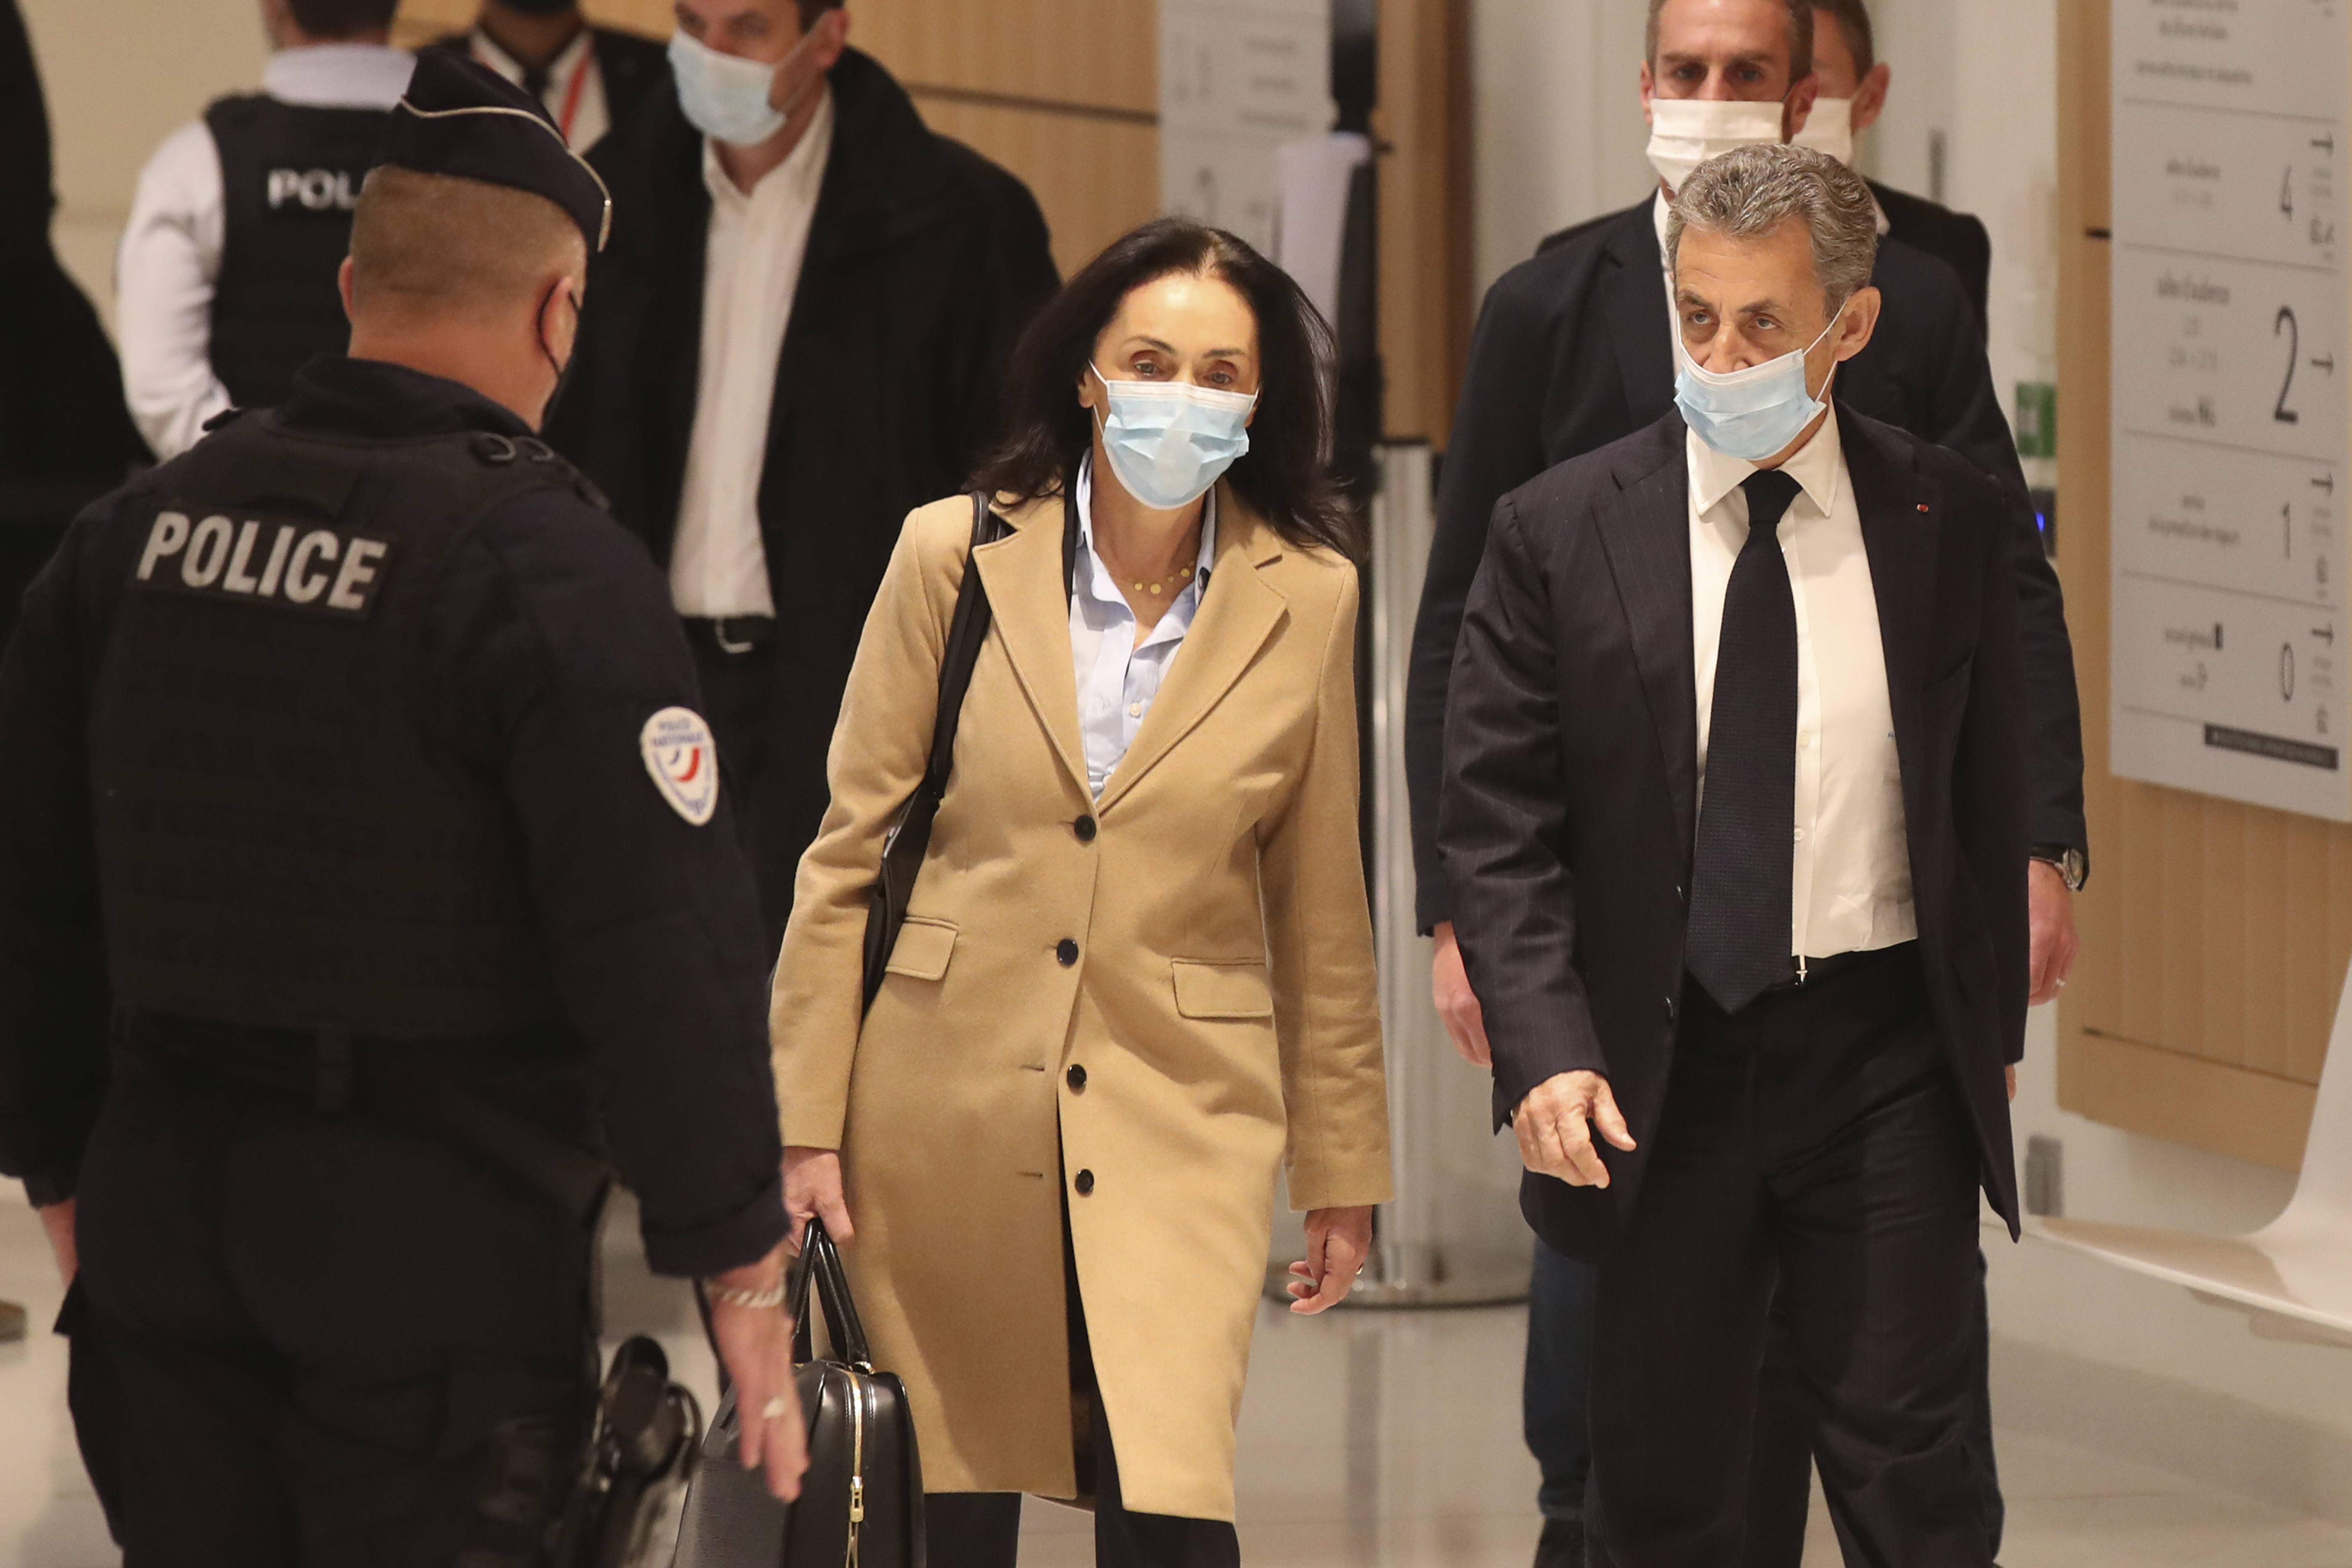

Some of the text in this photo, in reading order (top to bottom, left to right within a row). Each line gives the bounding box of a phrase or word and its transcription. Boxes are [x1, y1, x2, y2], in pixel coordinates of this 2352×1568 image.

[267, 168, 361, 210] POL
[2279, 164, 2294, 221] 4
[2274, 304, 2299, 425] 2
[2281, 503, 2291, 560] 1
[136, 510, 389, 611] POLICE
